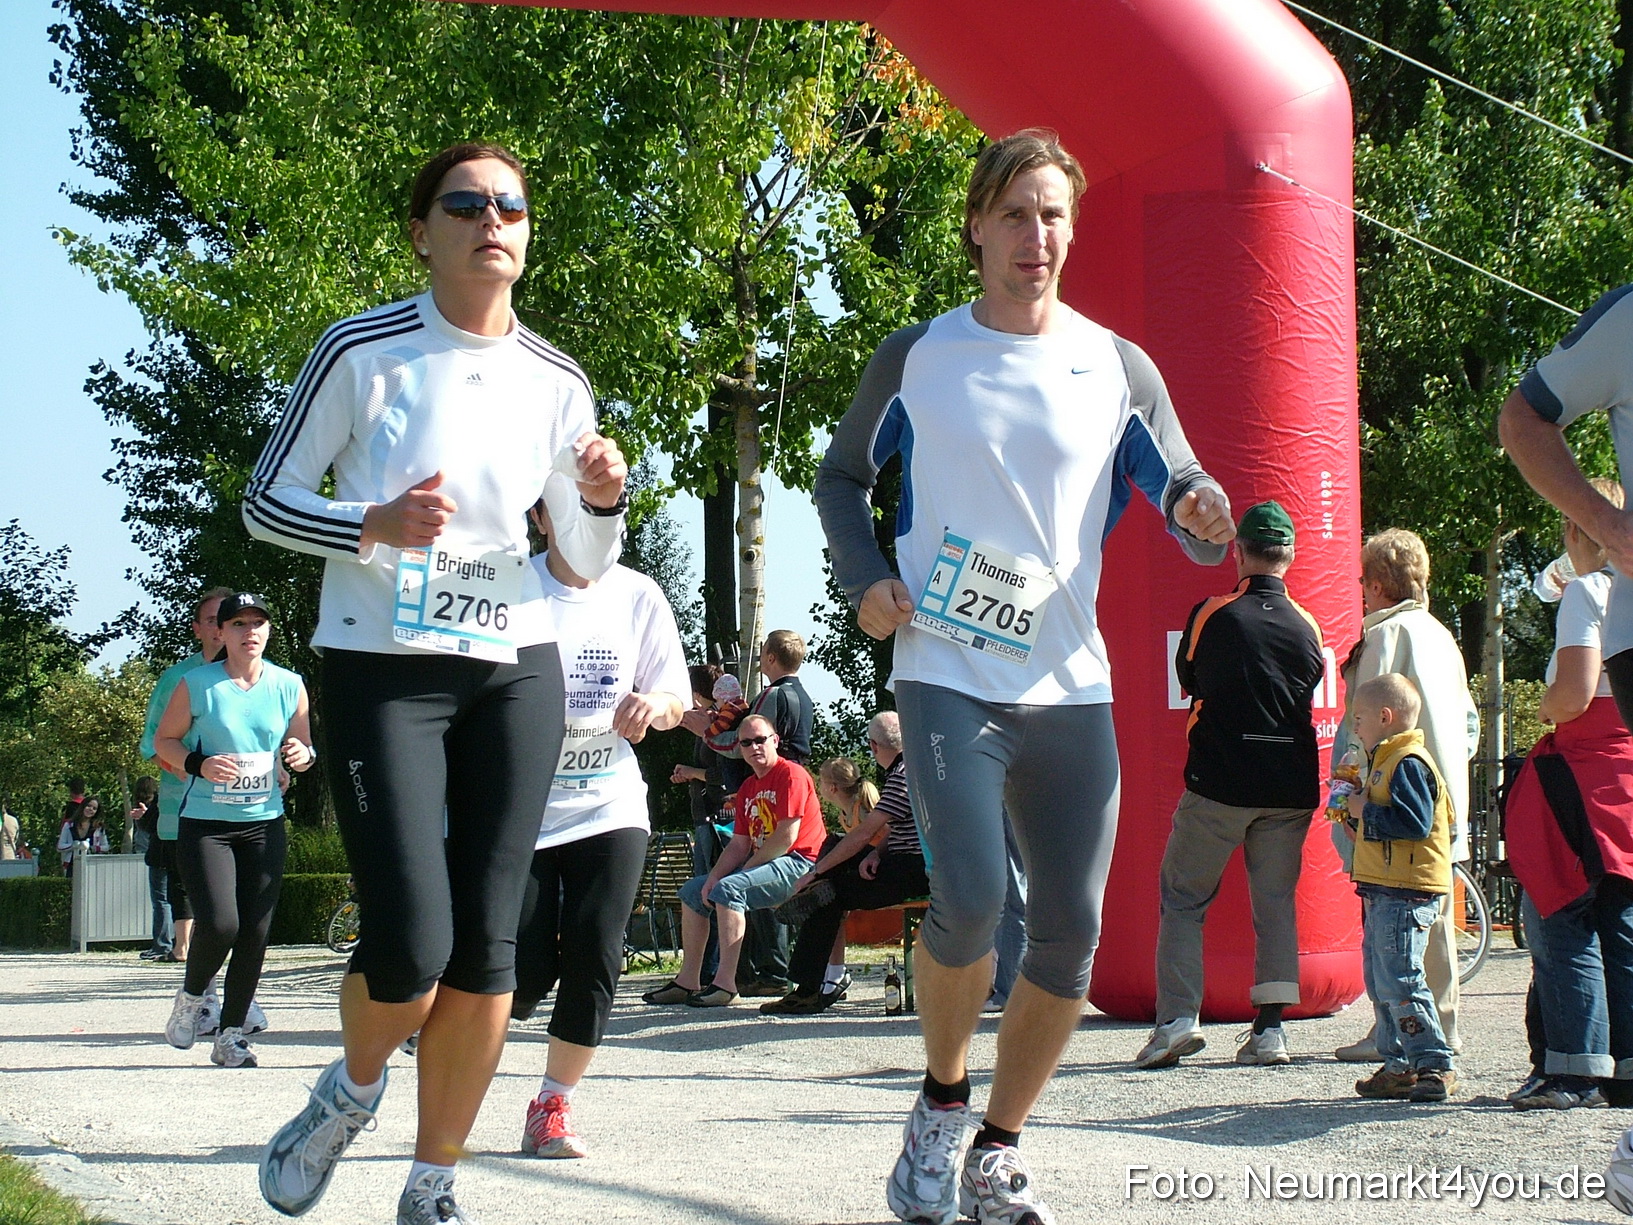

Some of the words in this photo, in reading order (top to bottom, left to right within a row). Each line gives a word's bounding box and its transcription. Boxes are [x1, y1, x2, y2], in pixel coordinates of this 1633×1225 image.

[1320, 470, 1333, 506] 1929
[436, 551, 496, 581] Brigitte
[970, 552, 1027, 589] Thomas
[402, 578, 410, 594] A
[932, 571, 942, 585] A
[433, 591, 508, 631] 2706
[955, 588, 1034, 636] 2705
[914, 613, 960, 636] BOCK
[986, 639, 1029, 660] PFLEIDERER
[575, 663, 620, 671] 16.09.2007
[565, 690, 618, 699] eumarkter
[235, 760, 255, 768] atrin
[562, 747, 613, 771] 2027
[231, 774, 268, 790] 2031
